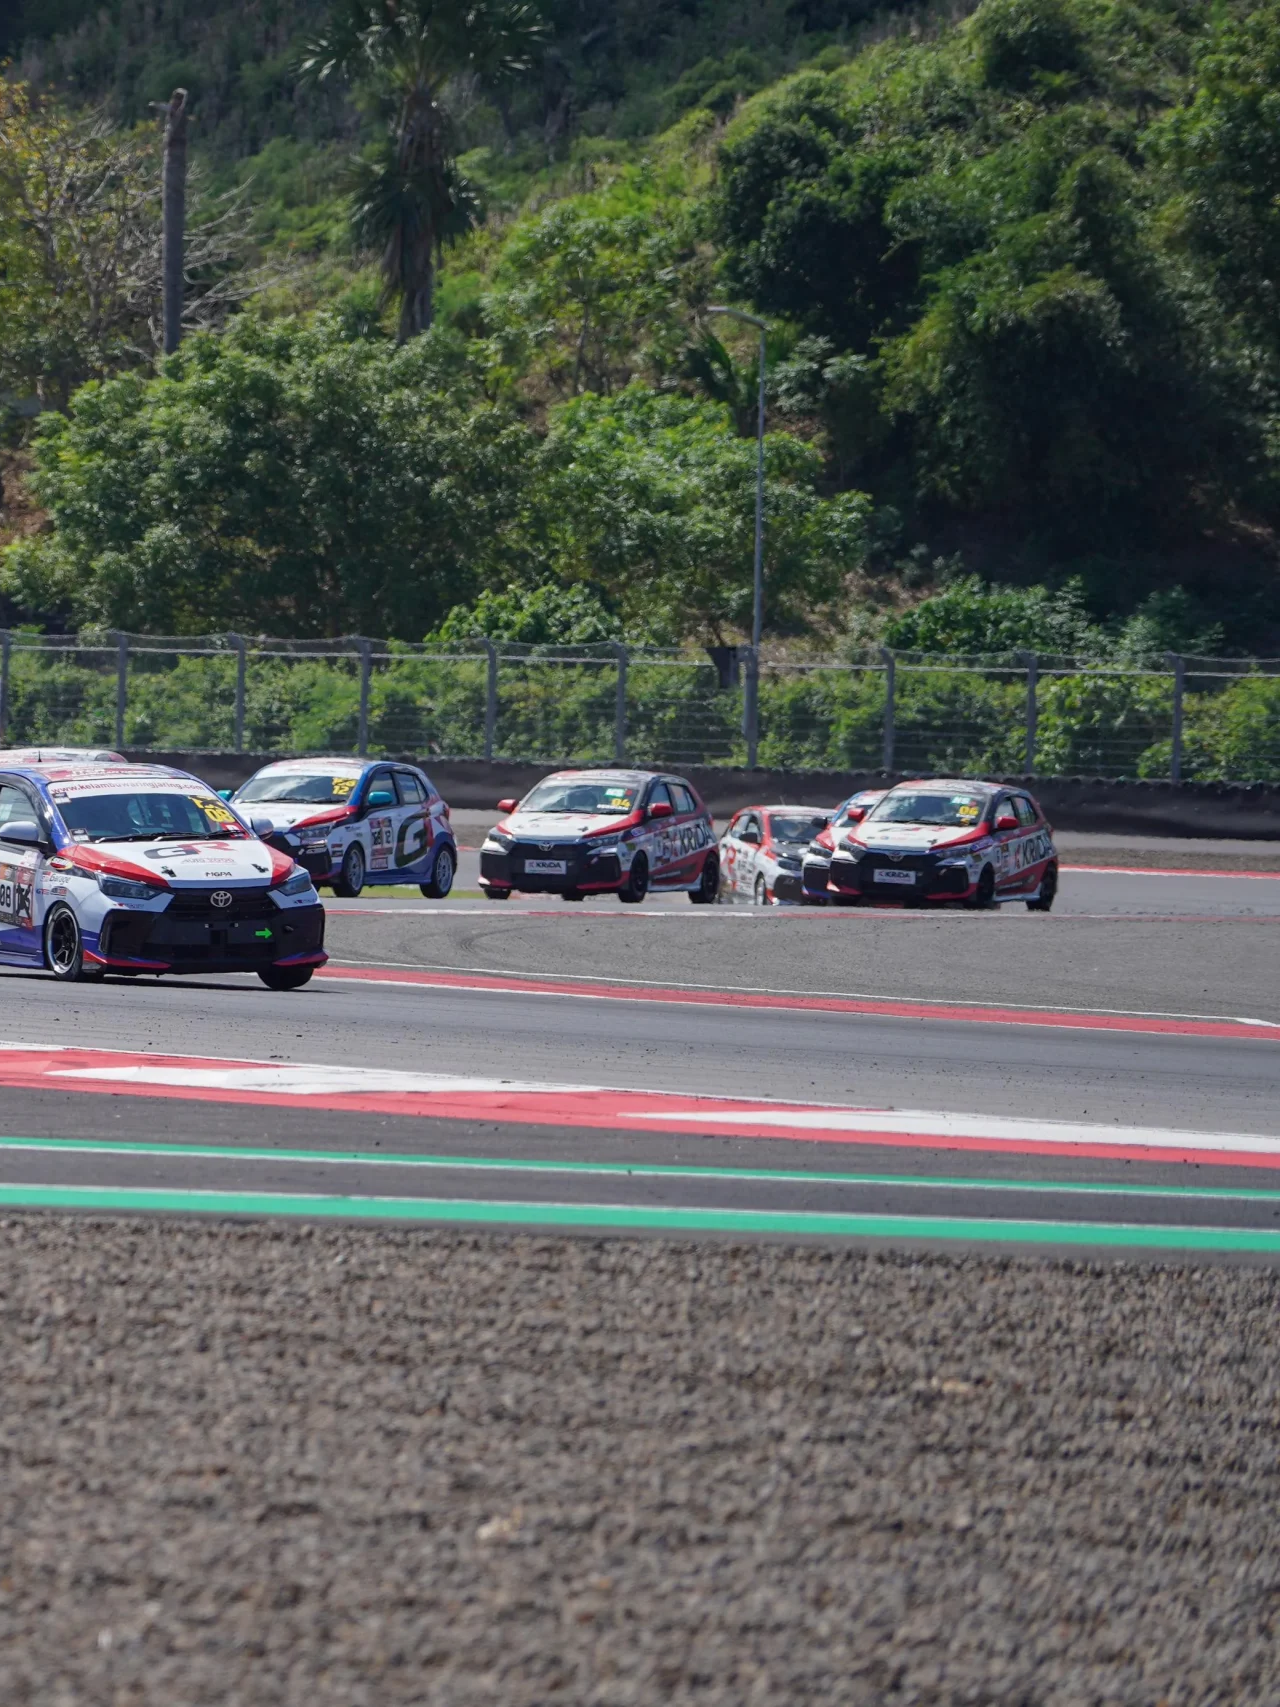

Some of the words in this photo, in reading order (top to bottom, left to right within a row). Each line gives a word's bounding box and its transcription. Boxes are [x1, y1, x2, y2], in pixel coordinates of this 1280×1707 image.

[51, 781, 206, 796] www.kelambuwaringjaring.com
[332, 785, 350, 795] 12
[204, 808, 236, 823] 08
[0, 884, 12, 908] 08
